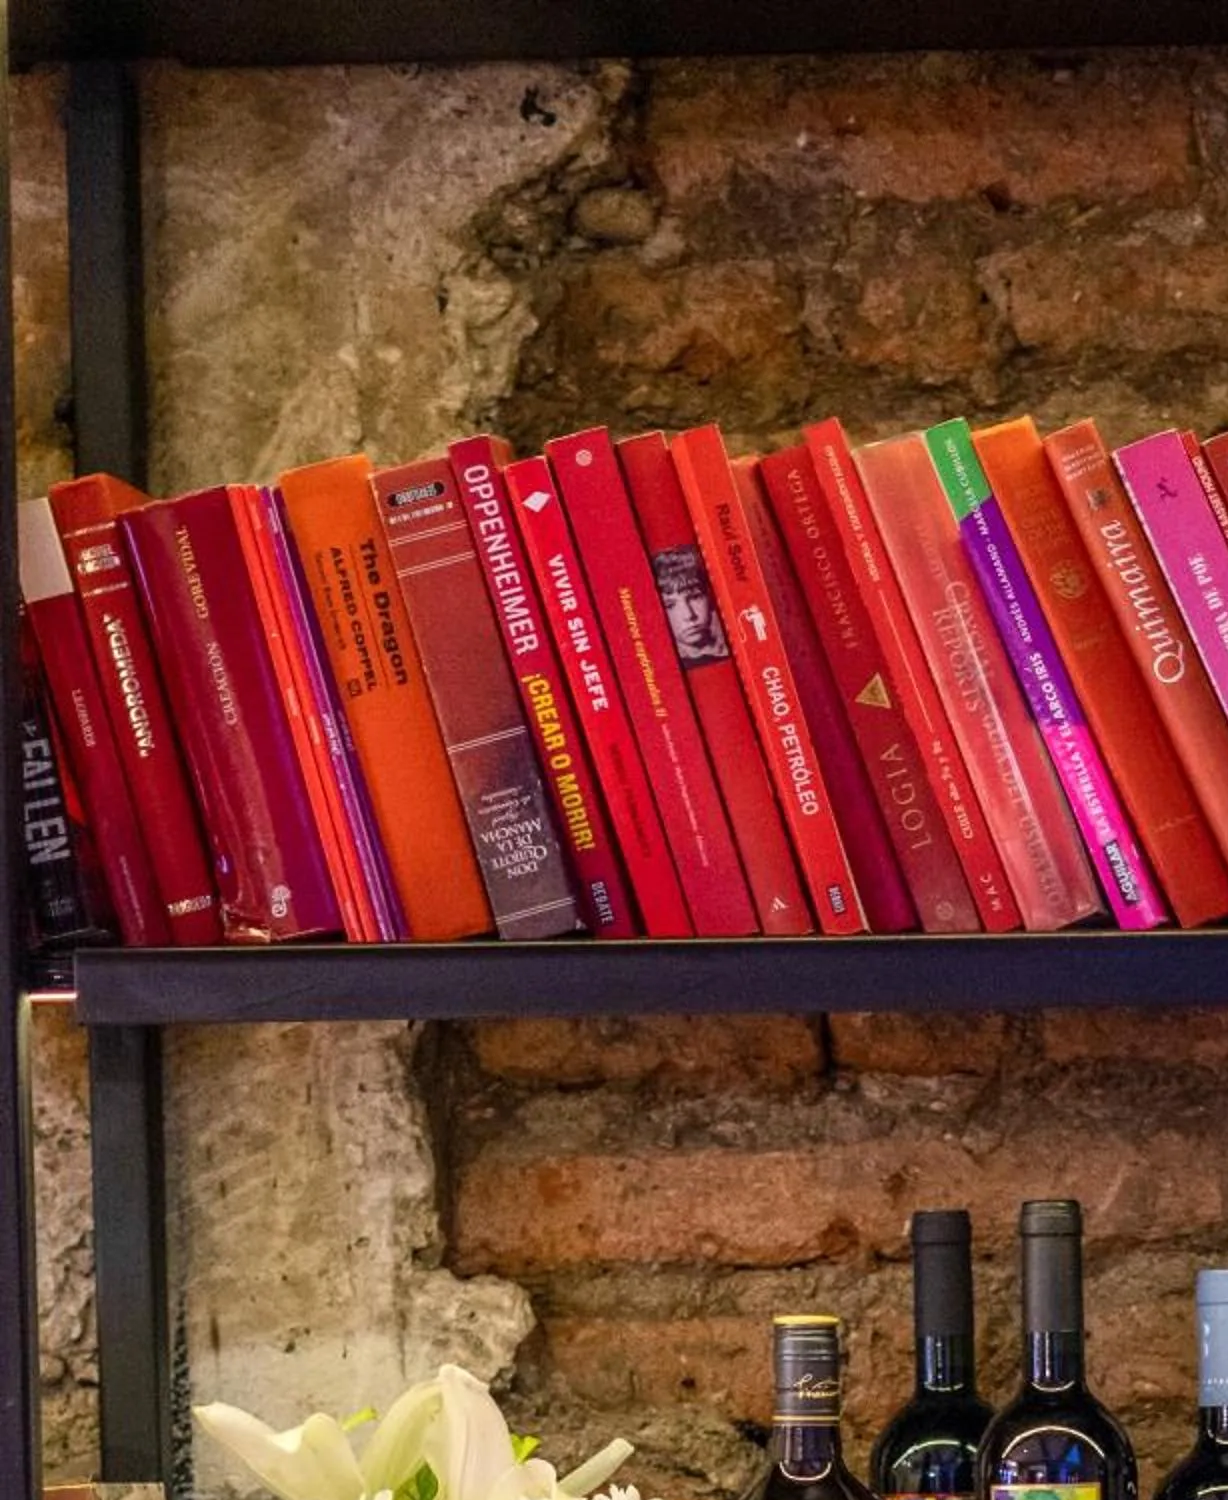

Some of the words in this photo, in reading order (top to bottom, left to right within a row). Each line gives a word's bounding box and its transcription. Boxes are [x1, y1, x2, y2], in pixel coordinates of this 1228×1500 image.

[780, 466, 824, 542] ORTEGA
[172, 525, 200, 576] VIDAL
[355, 537, 385, 585] The
[462, 462, 540, 657] OPPENHEIMER
[542, 551, 581, 612] VIVIR
[1186, 552, 1213, 587] POE
[327, 543, 360, 616] ALFRED
[346, 618, 380, 692] COPPEL
[806, 545, 863, 651] FRANCISCO
[1202, 587, 1223, 612] DE
[367, 588, 415, 687] Dragon
[563, 614, 592, 652] SIN
[924, 604, 992, 714] REPORTS
[575, 654, 612, 711] JEFE
[756, 663, 795, 723] CHAO,
[1025, 651, 1051, 683] IRIS
[519, 669, 568, 750] ¡CREAR
[1038, 680, 1068, 722] ARCO
[548, 751, 573, 772] O
[772, 720, 827, 817] PETRÓLEO
[550, 770, 601, 853] MORIR!
[876, 741, 933, 851] LOGIA
[1097, 841, 1146, 904] AGUILAR
